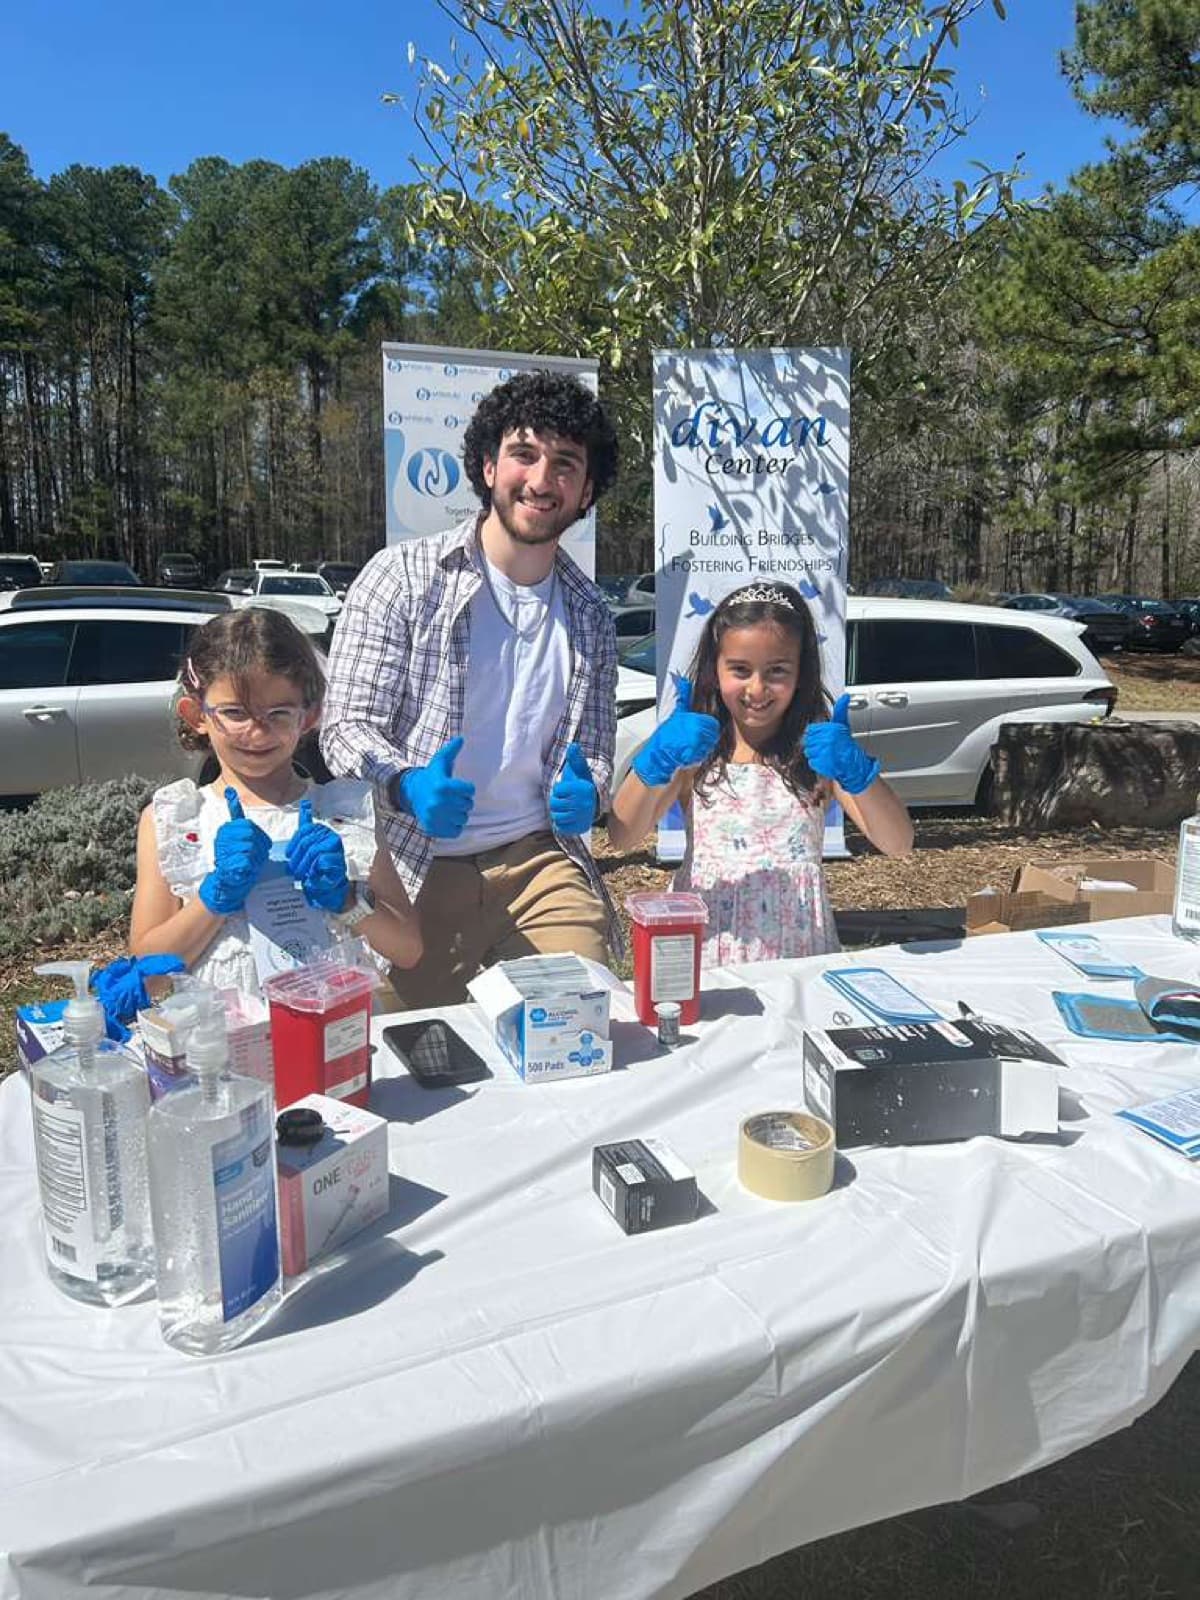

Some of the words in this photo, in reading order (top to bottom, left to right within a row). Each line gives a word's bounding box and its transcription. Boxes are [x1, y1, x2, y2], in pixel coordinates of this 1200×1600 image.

[671, 401, 832, 448] divan
[705, 454, 795, 475] Center
[545, 1061, 565, 1071] Pads
[313, 1166, 341, 1196] ONE
